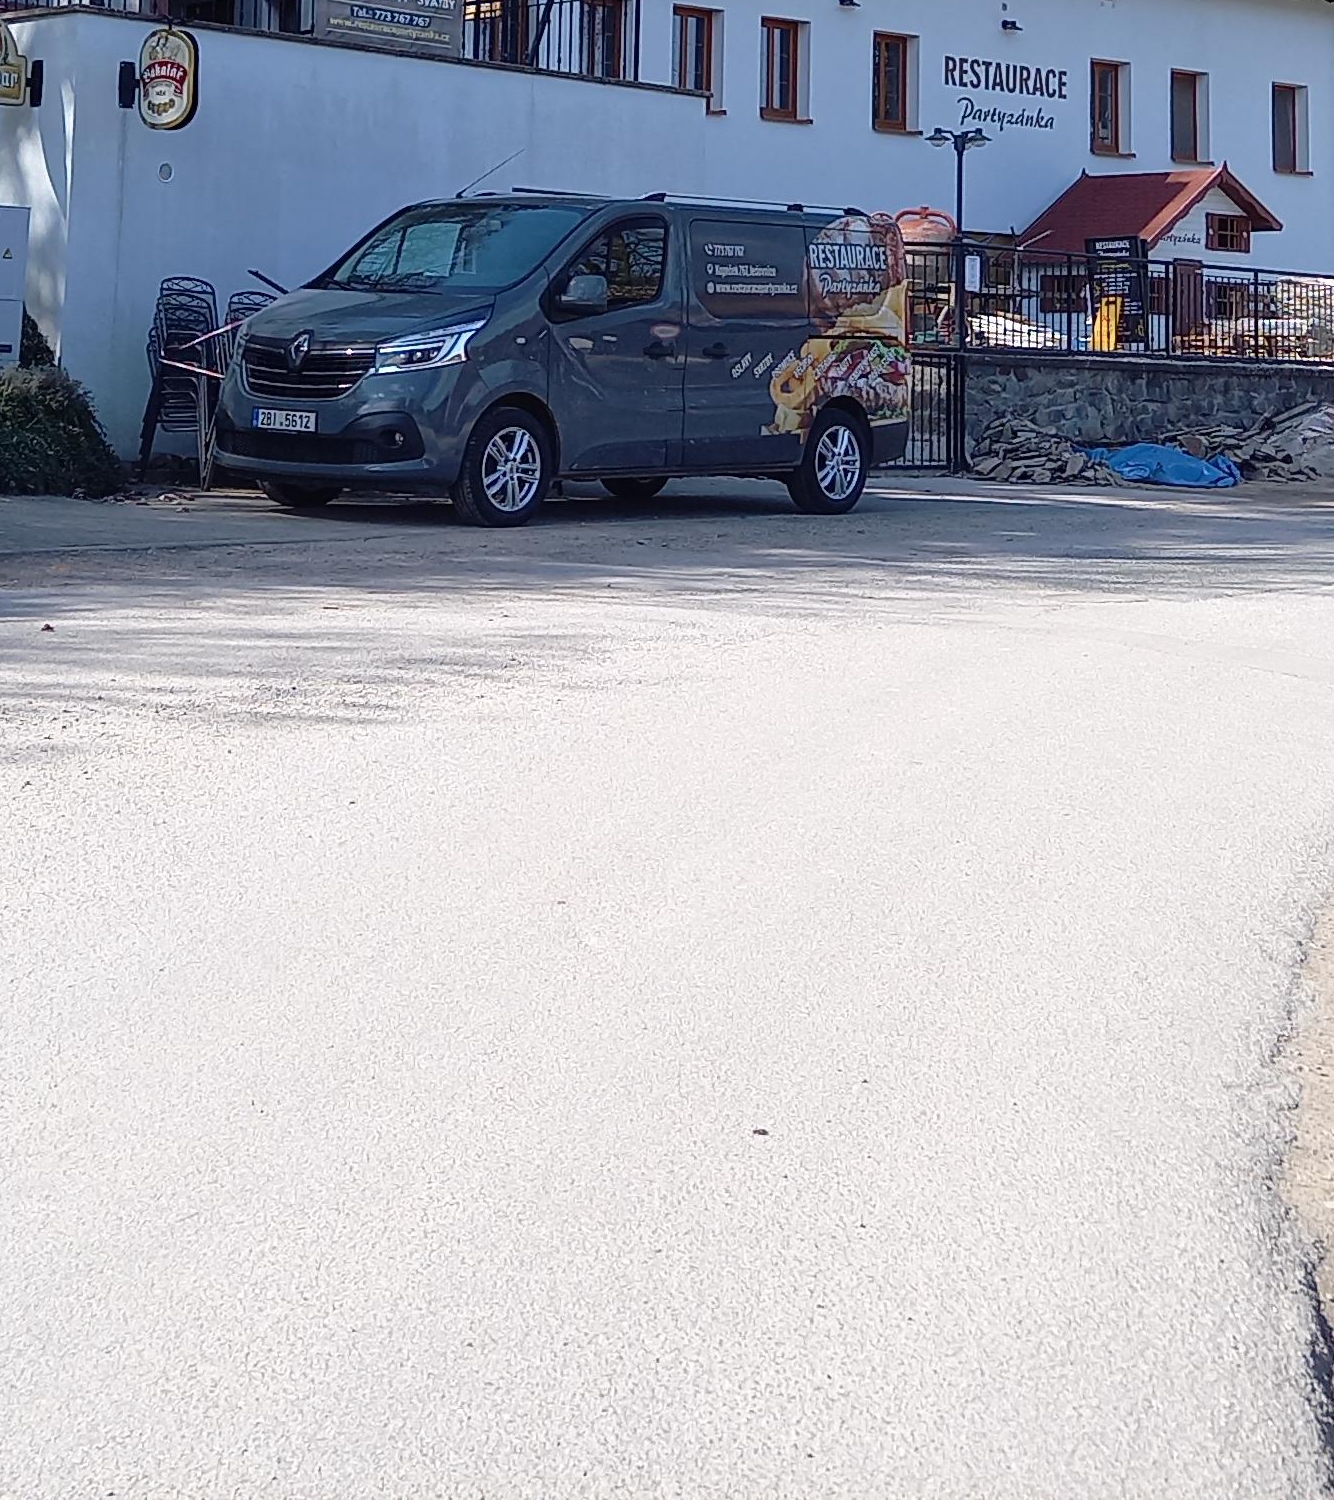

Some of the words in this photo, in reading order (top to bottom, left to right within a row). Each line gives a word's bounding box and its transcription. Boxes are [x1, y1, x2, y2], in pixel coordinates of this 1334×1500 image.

[374, 10, 392, 21] 773
[393, 13, 411, 25] 767
[412, 17, 430, 27] 767
[944, 55, 1068, 100] RESTAURACE
[956, 97, 1055, 132] Partyzánka
[809, 244, 886, 270] RESTAURACE
[820, 274, 881, 298] Partyzánka
[284, 413, 311, 429] 5612
